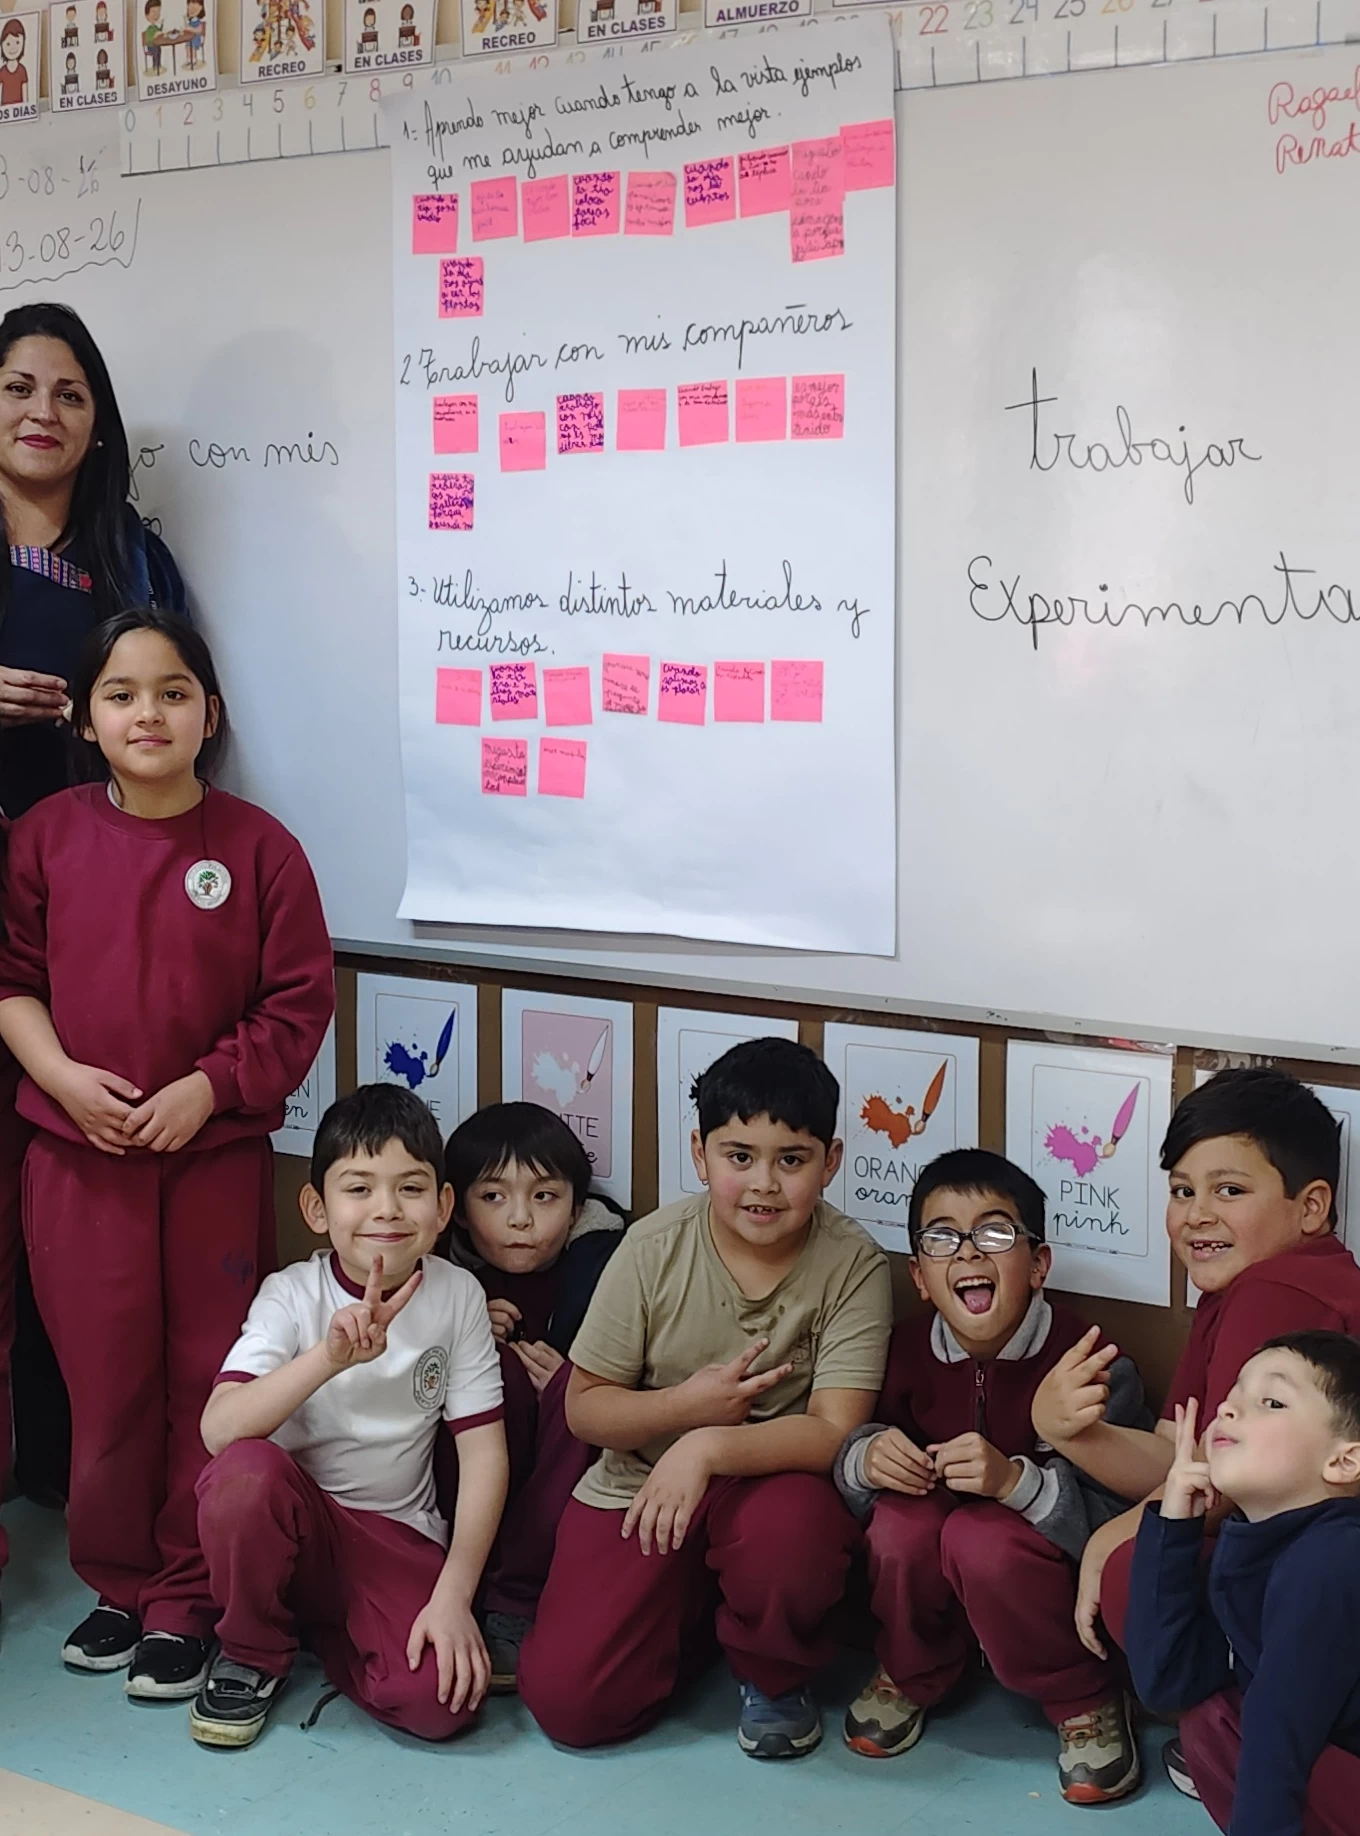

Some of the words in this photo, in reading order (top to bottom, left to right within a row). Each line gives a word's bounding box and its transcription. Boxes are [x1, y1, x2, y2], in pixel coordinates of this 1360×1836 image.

[587, 25, 608, 38] EN
[610, 16, 666, 35] CLASES
[716, 2, 800, 23] ALMUERZO
[918, 5, 949, 36] 22
[963, 1, 994, 31] 23
[482, 31, 536, 50] RECREO
[258, 60, 306, 78] RECREO
[354, 55, 371, 69] EN
[376, 50, 423, 66] CLASES
[59, 95, 74, 109] EN
[76, 91, 118, 107] CLASES
[146, 77, 208, 97] DESAYUNO
[183, 101, 194, 125] 2
[212, 98, 224, 122] 3
[243, 93, 254, 117] 4
[273, 89, 285, 113] 5
[304, 86, 316, 110] 6
[336, 81, 348, 106] 7
[369, 78, 381, 102] 8
[490, 102, 546, 139] mejor
[621, 74, 676, 111] tengo
[683, 82, 700, 98] a
[710, 65, 738, 97] la
[740, 55, 789, 89] vista
[792, 52, 863, 97] ejemplos
[462, 153, 492, 170] me
[501, 127, 585, 180] ayudan
[589, 141, 602, 157] a
[554, 343, 606, 371] con
[617, 313, 672, 355] mis
[189, 438, 251, 469] con
[264, 431, 340, 468] mis
[1004, 366, 1263, 506] trabajar
[433, 568, 550, 636] Utilizamos
[559, 570, 658, 618] distintos
[666, 558, 822, 616] materiales
[837, 598, 871, 639] y
[1060, 1179, 1120, 1210] PINK
[1052, 1210, 1130, 1237] pink
